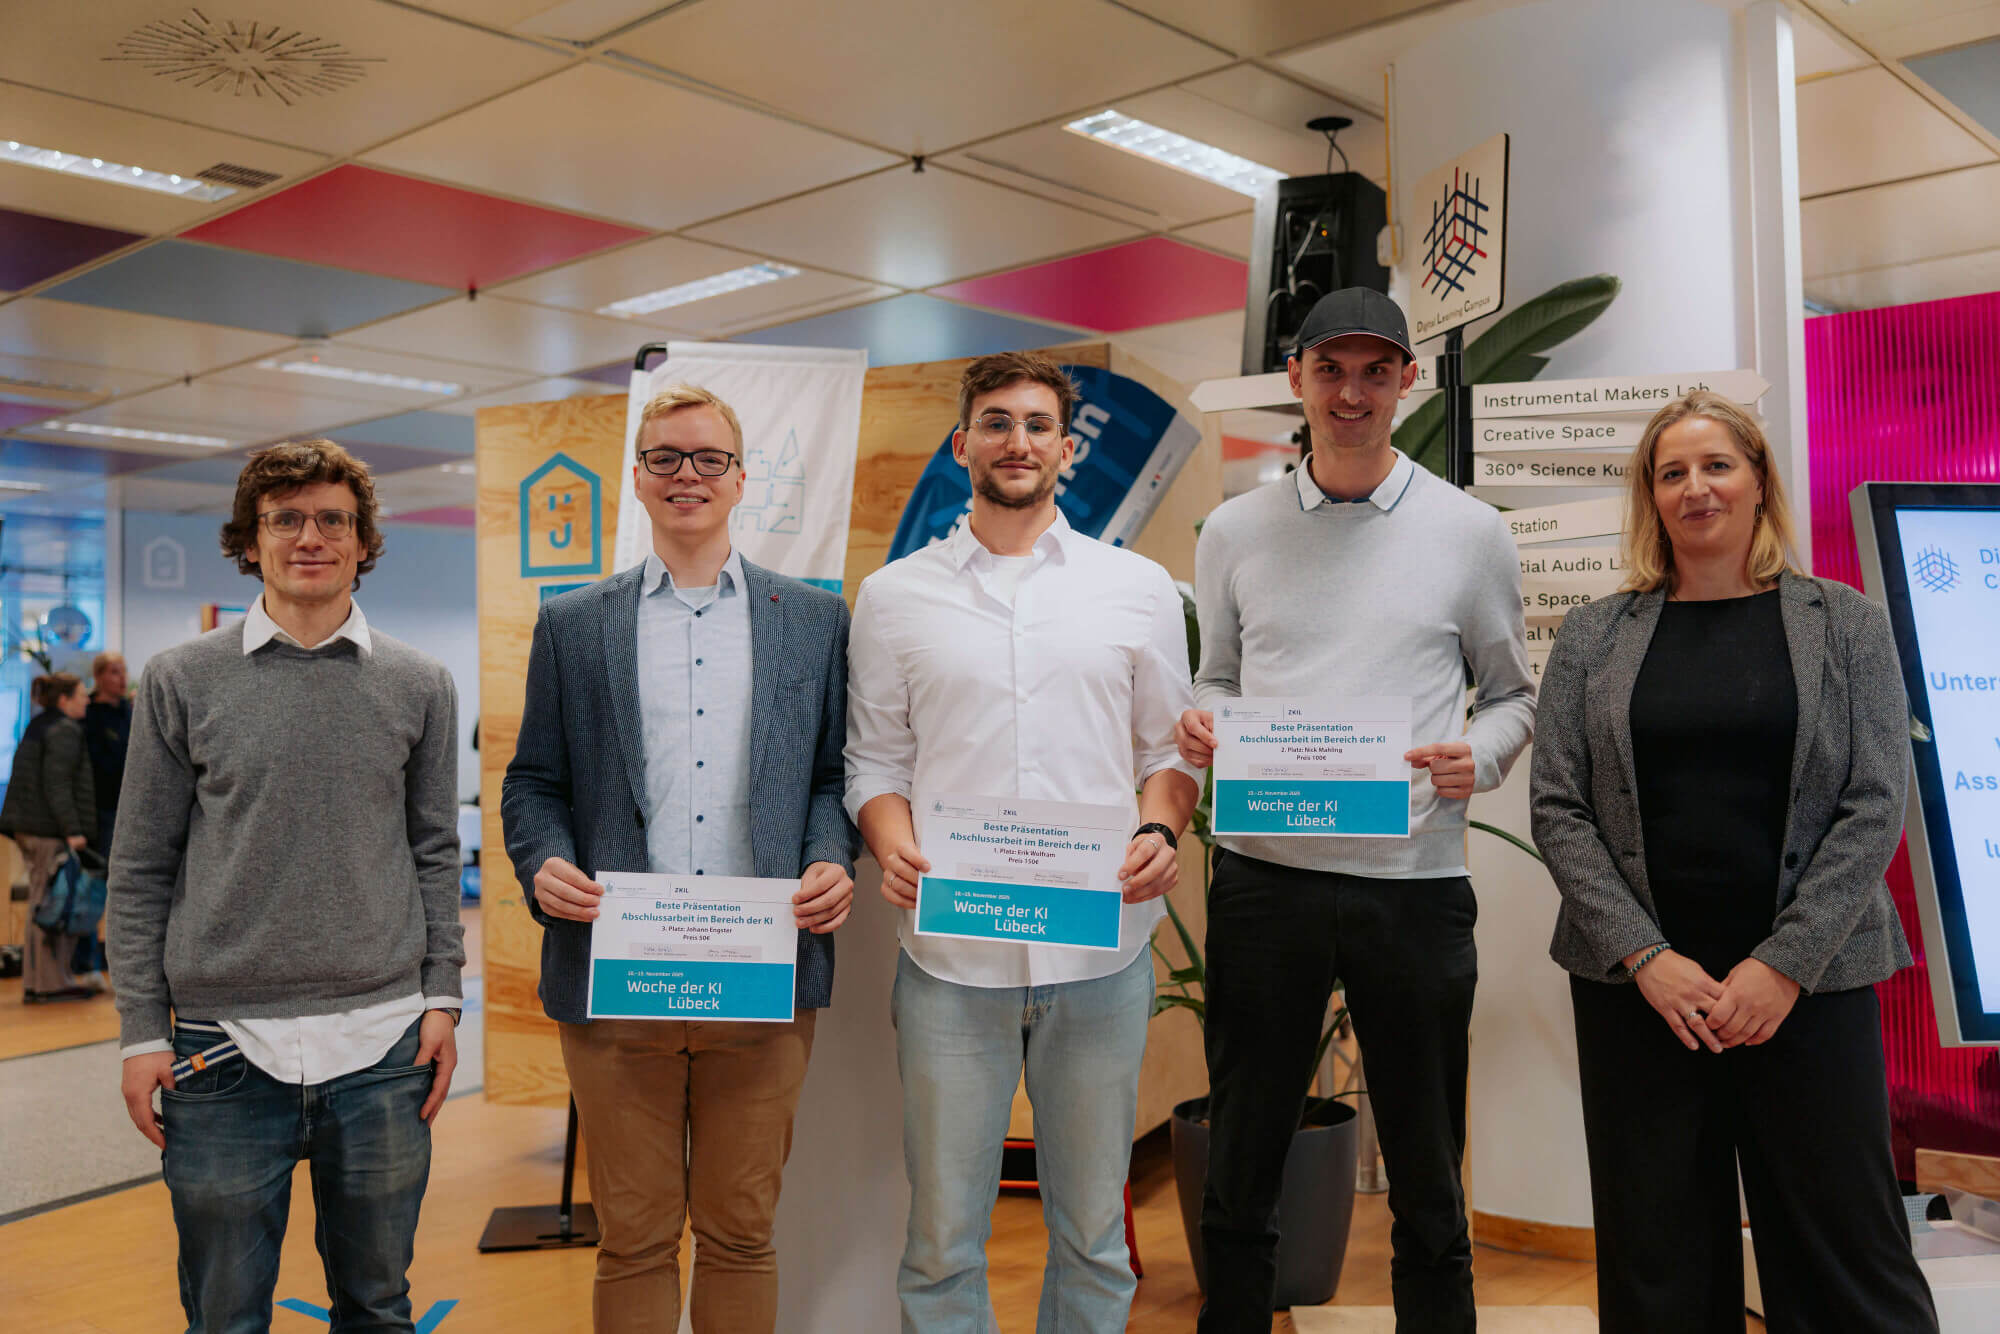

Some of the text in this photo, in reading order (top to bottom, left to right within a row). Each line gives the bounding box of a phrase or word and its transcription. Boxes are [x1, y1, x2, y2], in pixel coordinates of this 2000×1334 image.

[1483, 388, 1598, 408] Instrumental
[1605, 386, 1669, 401] Makers
[1483, 425, 1616, 441] Creative Space
[1485, 463, 1524, 476] 360°
[1530, 463, 1596, 477] Science
[1511, 518, 1558, 535] Station
[1552, 557, 1602, 572] Audio
[1537, 593, 1591, 608] Space
[1271, 722, 1353, 732] Beste Präsentation
[1239, 735, 1386, 744] Abschlussarbeit im Bereich der KI
[1247, 799, 1338, 812] Woche der KI
[1286, 814, 1336, 827] Lübeck
[983, 822, 1069, 837] Beste Präsentation
[949, 832, 1101, 852] Abschlussarbeit im Bereich der KI
[655, 901, 741, 912] Beste Präsentation
[954, 899, 1048, 920] Woche der KI
[621, 911, 773, 925] Abschlussarbeit im Bereich der KI
[994, 918, 1046, 935] Lübeck
[627, 980, 722, 995] Woche der KI
[668, 997, 720, 1010] Lübeck
